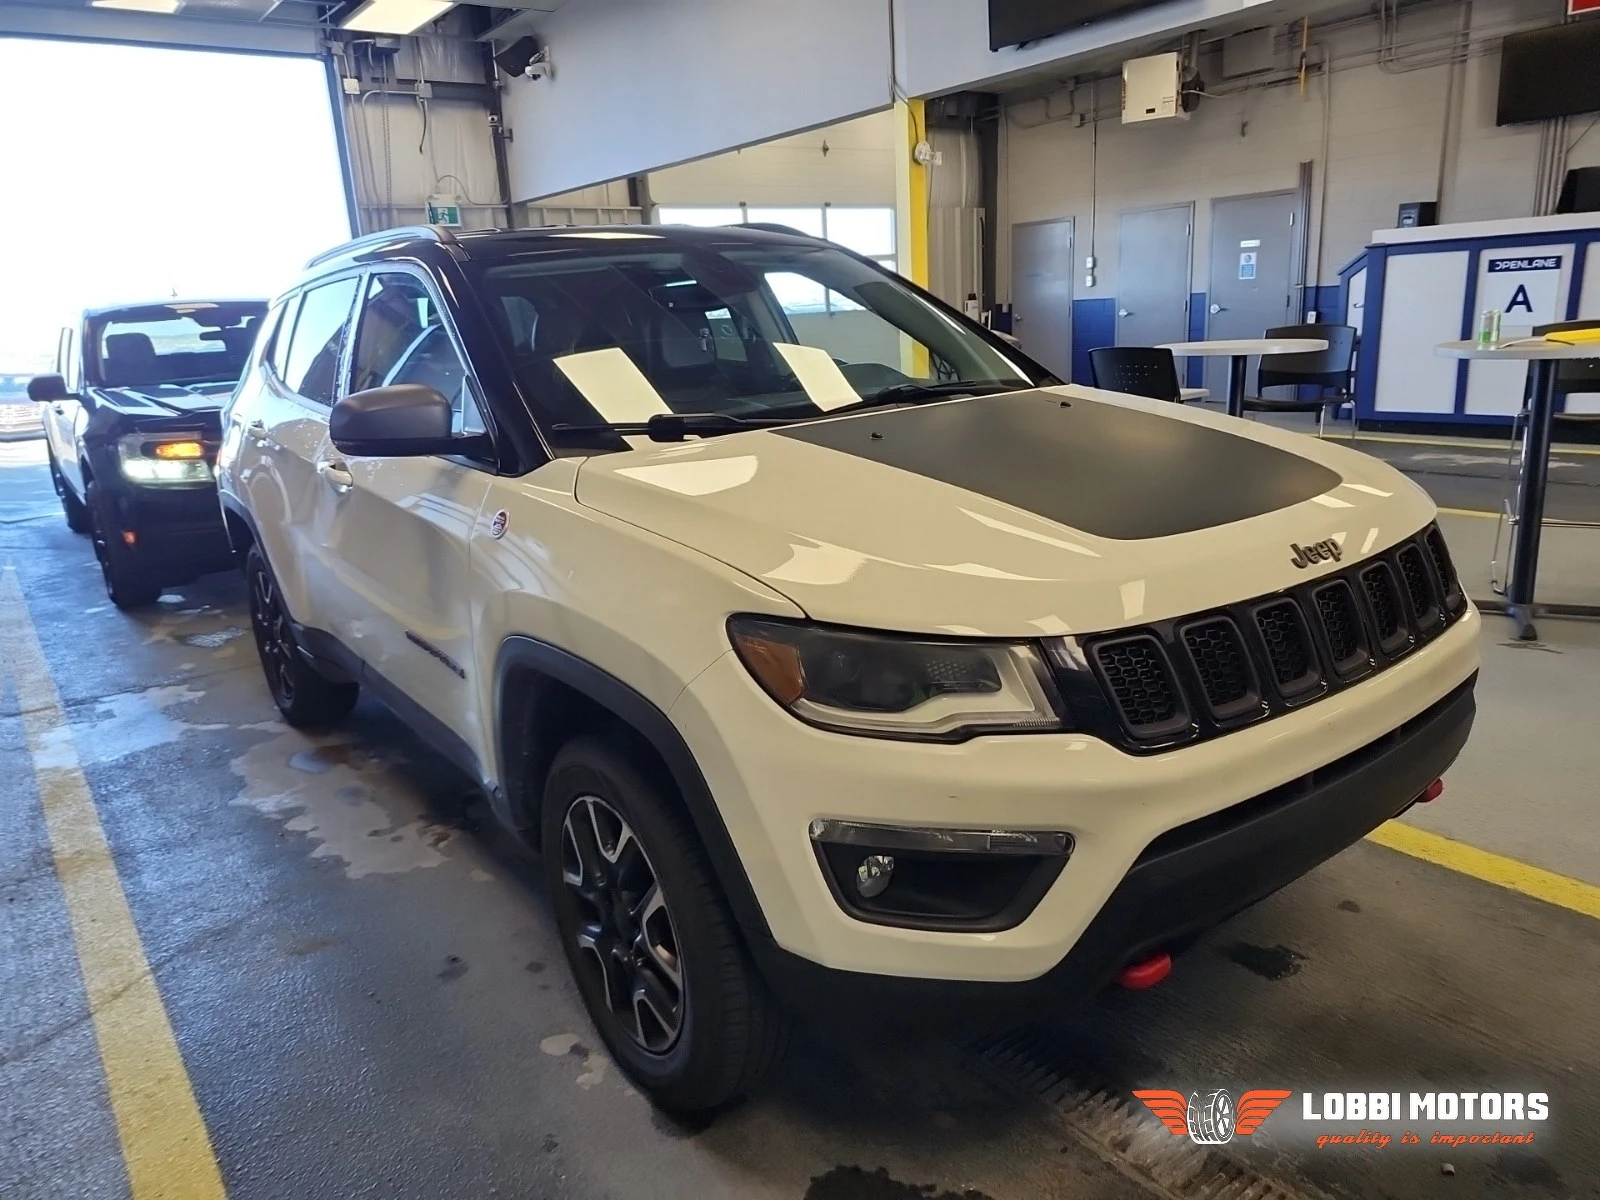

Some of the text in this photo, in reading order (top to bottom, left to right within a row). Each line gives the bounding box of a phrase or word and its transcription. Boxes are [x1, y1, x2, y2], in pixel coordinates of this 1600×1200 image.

[1494, 258, 1557, 270] OPENLANE
[1504, 284, 1533, 313] A
[1289, 538, 1342, 569] Jeep
